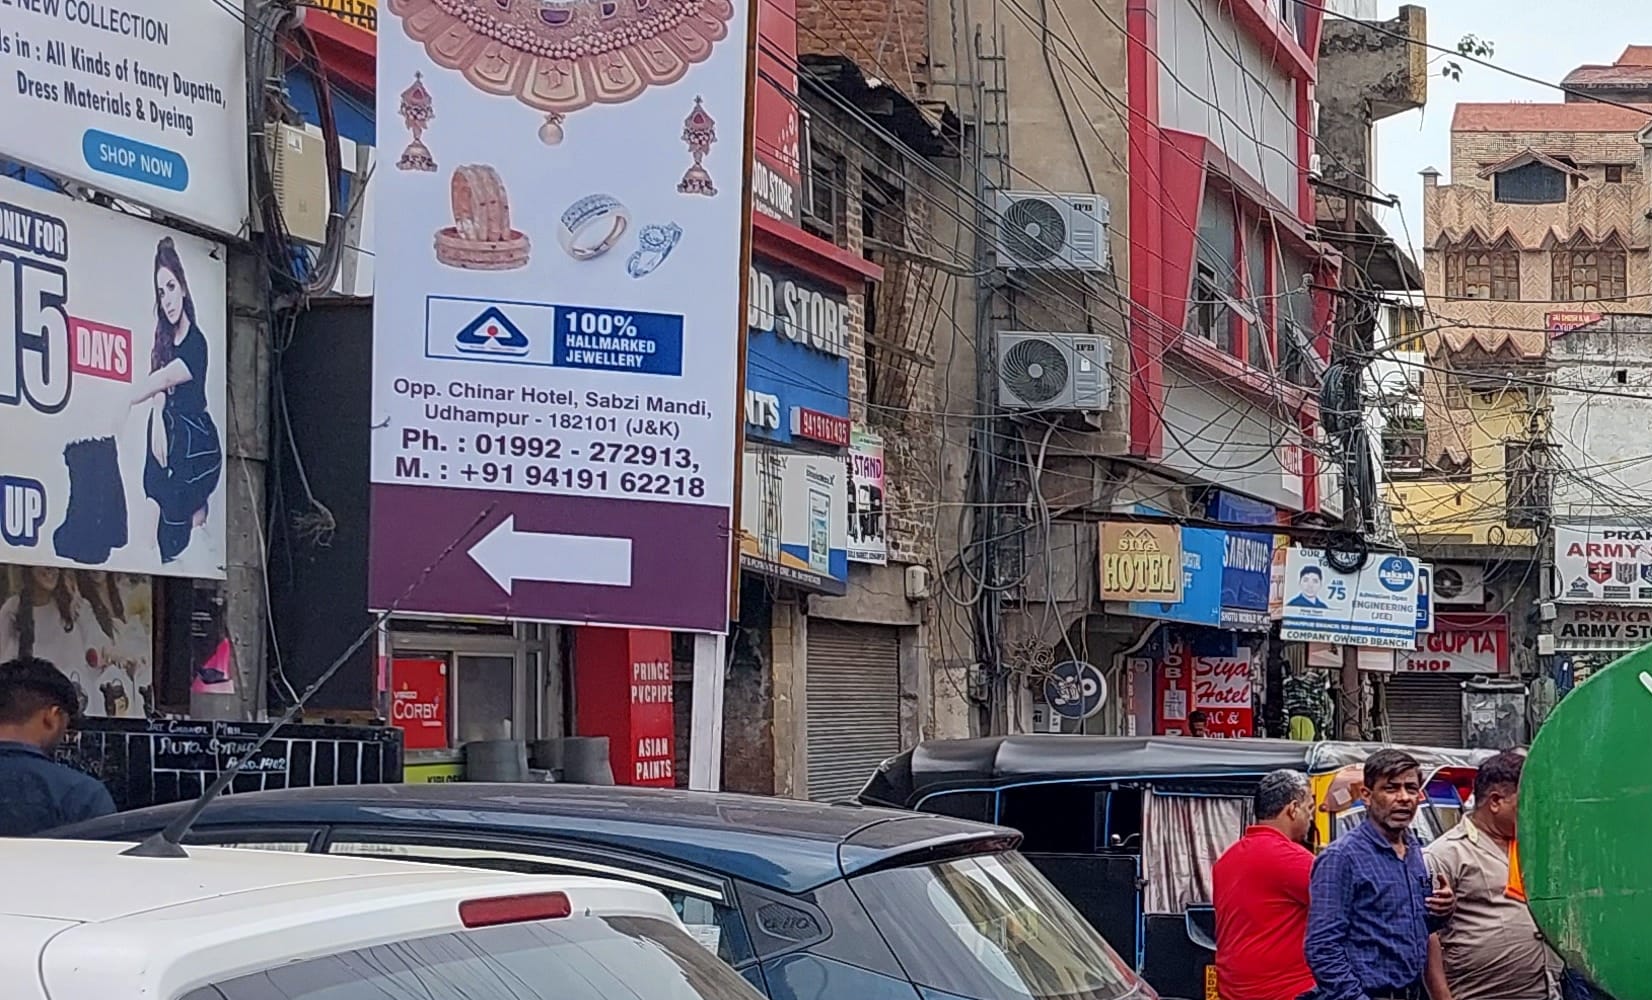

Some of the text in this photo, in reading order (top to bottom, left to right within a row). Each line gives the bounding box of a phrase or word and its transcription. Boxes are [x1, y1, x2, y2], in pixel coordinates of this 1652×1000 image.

[65, 0, 169, 46] COLLECTION
[15, 32, 31, 59] in
[46, 40, 67, 67] All
[71, 45, 111, 78] Kinds
[115, 58, 129, 82] of
[134, 61, 169, 97] fancy
[173, 71, 226, 109] Dupatta,
[17, 69, 194, 136] Dress Materials & Dyeing
[99, 143, 173, 179] SHOP NOW
[769, 170, 793, 218] STORE
[0, 213, 65, 255] NLY FOR
[565, 311, 637, 337] 100%
[784, 280, 849, 358] STORE
[77, 326, 127, 375] DAYS
[566, 334, 656, 354] HALLMARKED
[566, 350, 644, 368] JEWELLERY
[393, 378, 713, 420] Opp. Chinar Hotel, Sabzi Mandi,
[425, 403, 529, 427] Udhampur
[549, 414, 617, 433] 182101
[626, 418, 681, 440] (J&K)
[402, 427, 447, 452] Ph.
[458, 436, 465, 452] :
[475, 433, 561, 459] 01992
[589, 442, 700, 473] 272913,
[395, 456, 705, 498] M. : +91 94191 62218
[855, 455, 882, 479] STAND
[4, 485, 42, 538] UP
[1119, 538, 1160, 552] SIYA
[1567, 542, 1643, 559] ARMY
[1103, 553, 1176, 593] HOTEL
[1327, 586, 1346, 600] 75
[1352, 601, 1413, 613] ENGINEERING
[1287, 631, 1408, 647] COMPANY OWNED BRANCH
[1427, 631, 1495, 653] GUPTA
[1561, 623, 1621, 637] ARMY
[633, 661, 671, 682] PRINCE
[1196, 658, 1250, 683] Siya
[1406, 660, 1451, 671] SHOP
[1196, 680, 1250, 703] Hotel
[394, 700, 440, 719] CORBY
[1227, 711, 1239, 725] &
[638, 737, 669, 758] ASIAN
[636, 760, 672, 782] PAINTS
